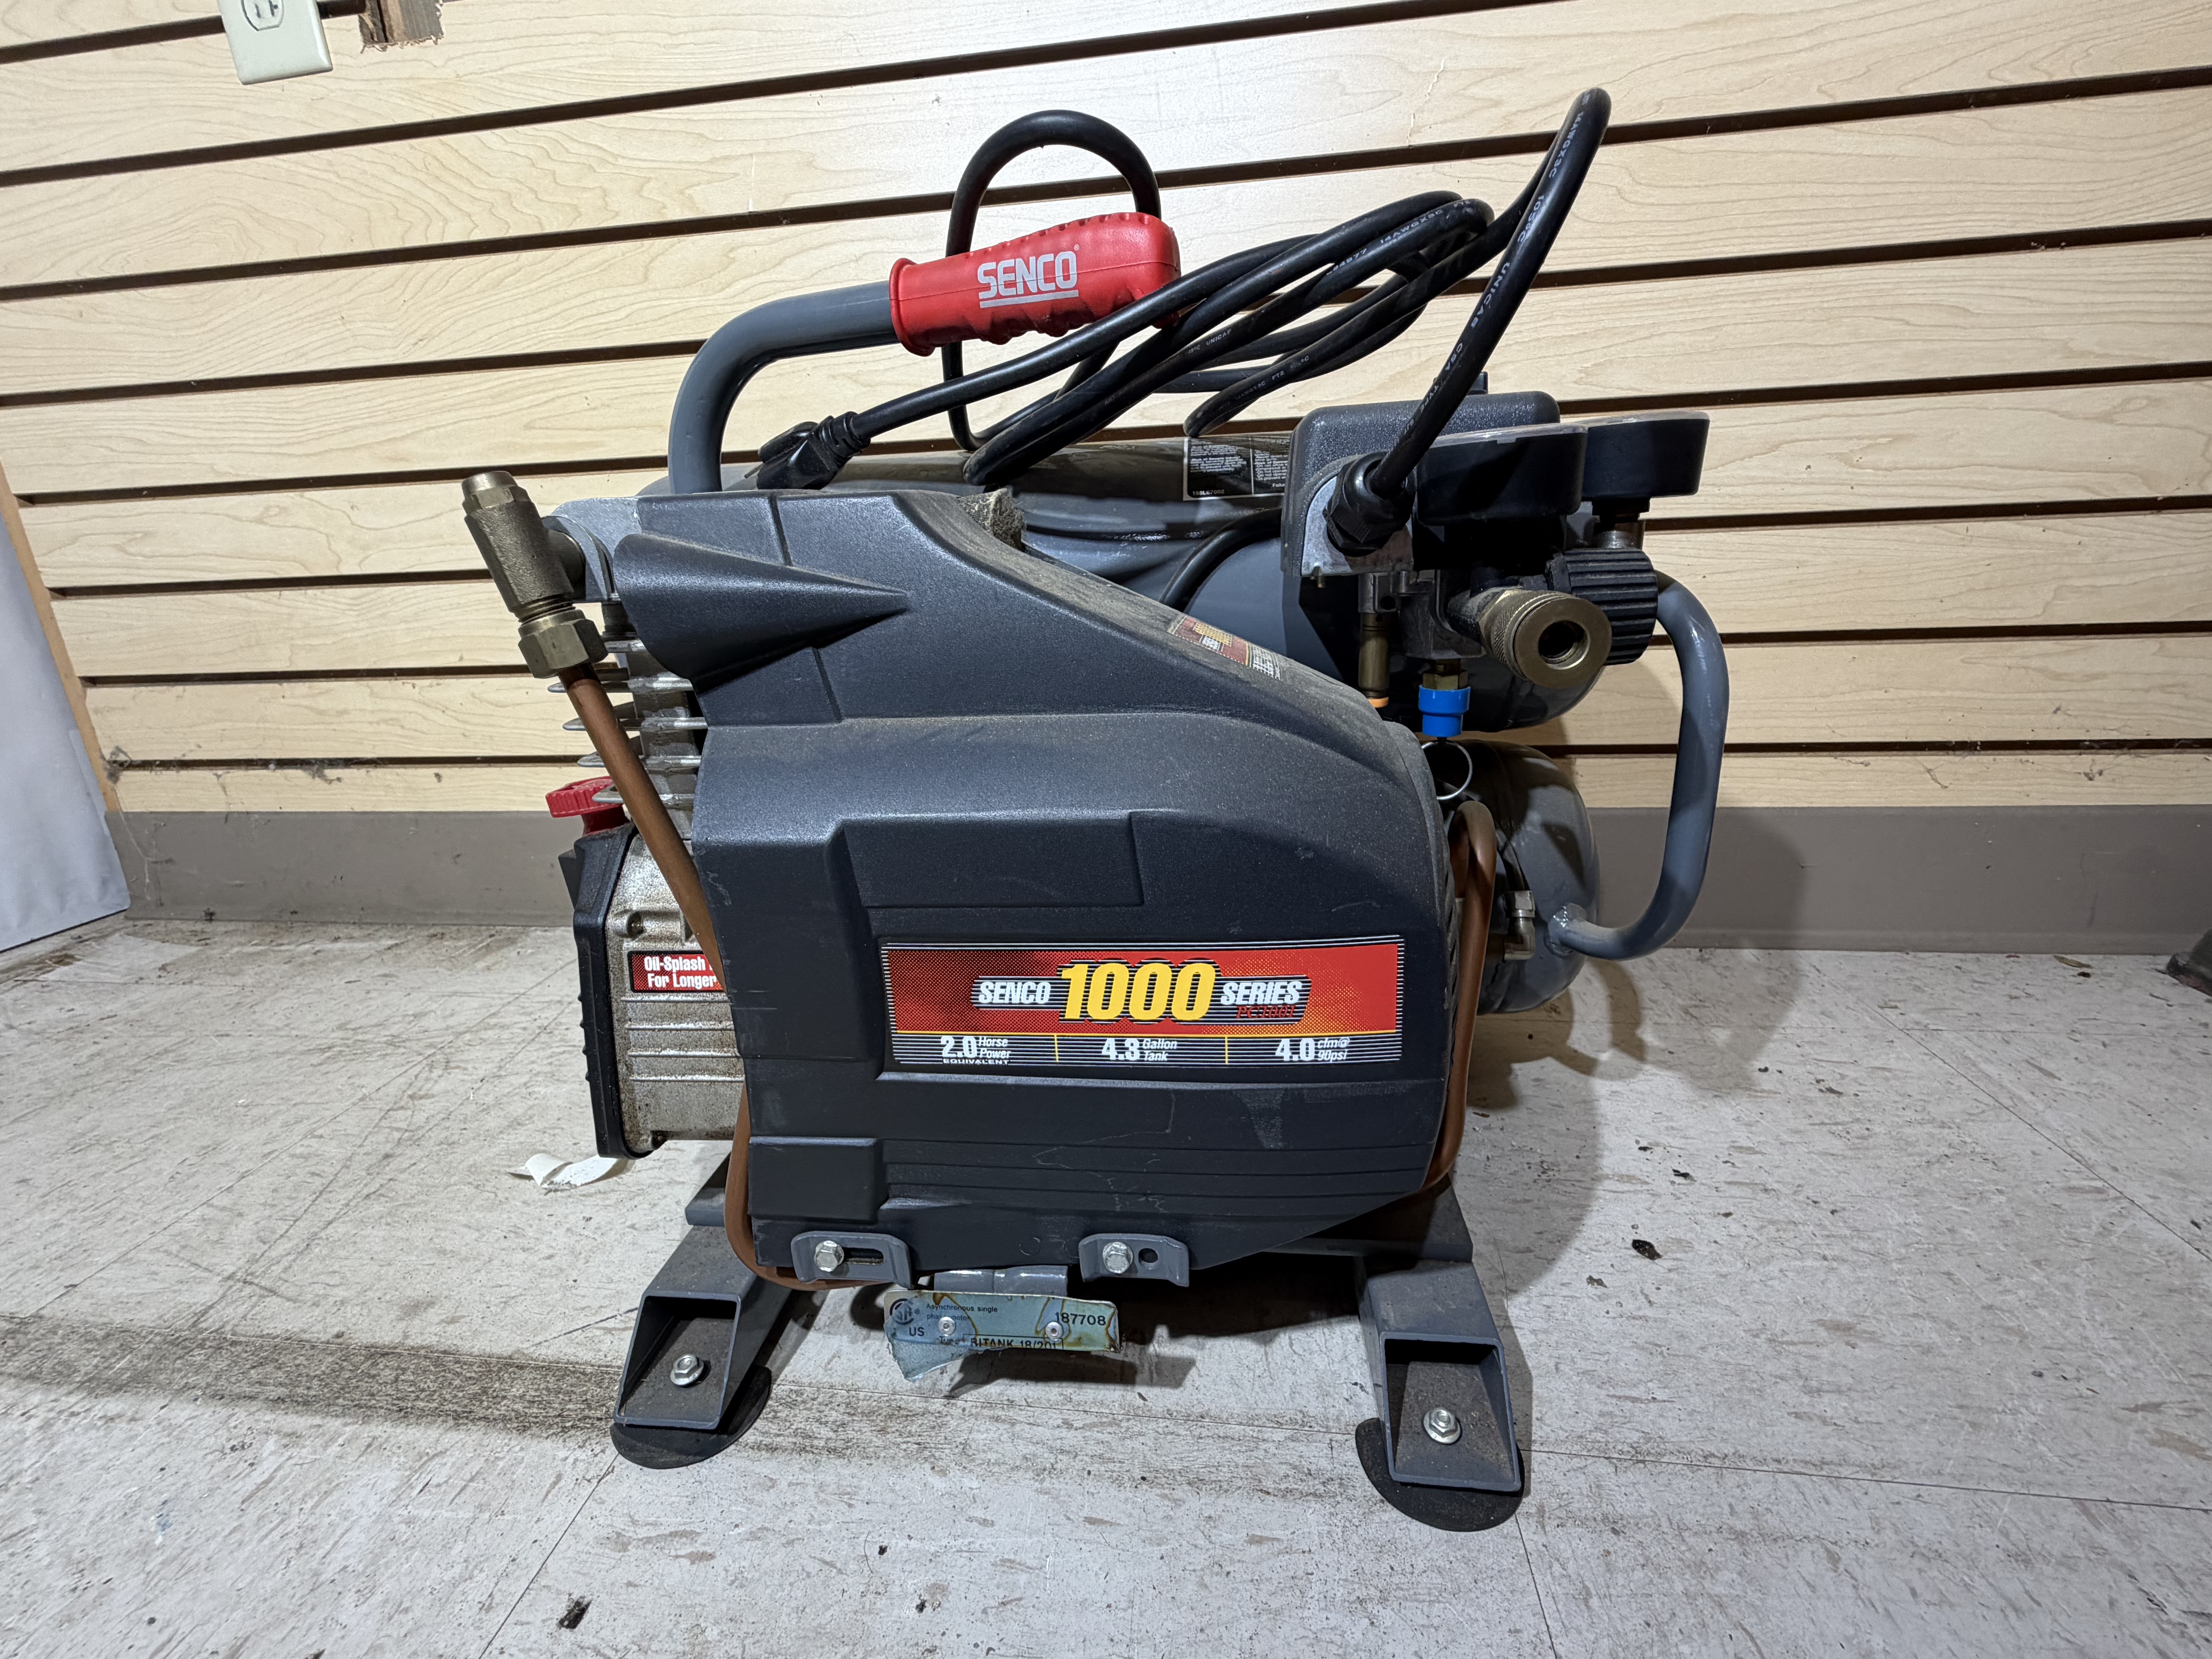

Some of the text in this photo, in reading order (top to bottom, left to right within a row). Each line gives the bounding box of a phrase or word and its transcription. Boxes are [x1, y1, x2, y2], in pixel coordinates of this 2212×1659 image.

[977, 251, 1078, 300] SENCO
[1471, 262, 1510, 328] UNICAB
[644, 956, 706, 973] Oil-Splash
[647, 973, 717, 990] For Longer
[978, 962, 1303, 1020] SENCO 1000 SERIES
[1235, 1005, 1296, 1018] PC1001
[940, 1036, 1008, 1058] 2.0 Horse
[979, 1048, 1012, 1059] Power
[1102, 1038, 1177, 1061] 4.3 Gallon
[1144, 1050, 1168, 1061] Tank
[1275, 1037, 1315, 1061] 4.0
[1317, 1049, 1348, 1063] 90psi
[926, 1303, 998, 1314] Asynchronous single
[1054, 1311, 1106, 1326] 187708
[909, 1327, 925, 1336] US
